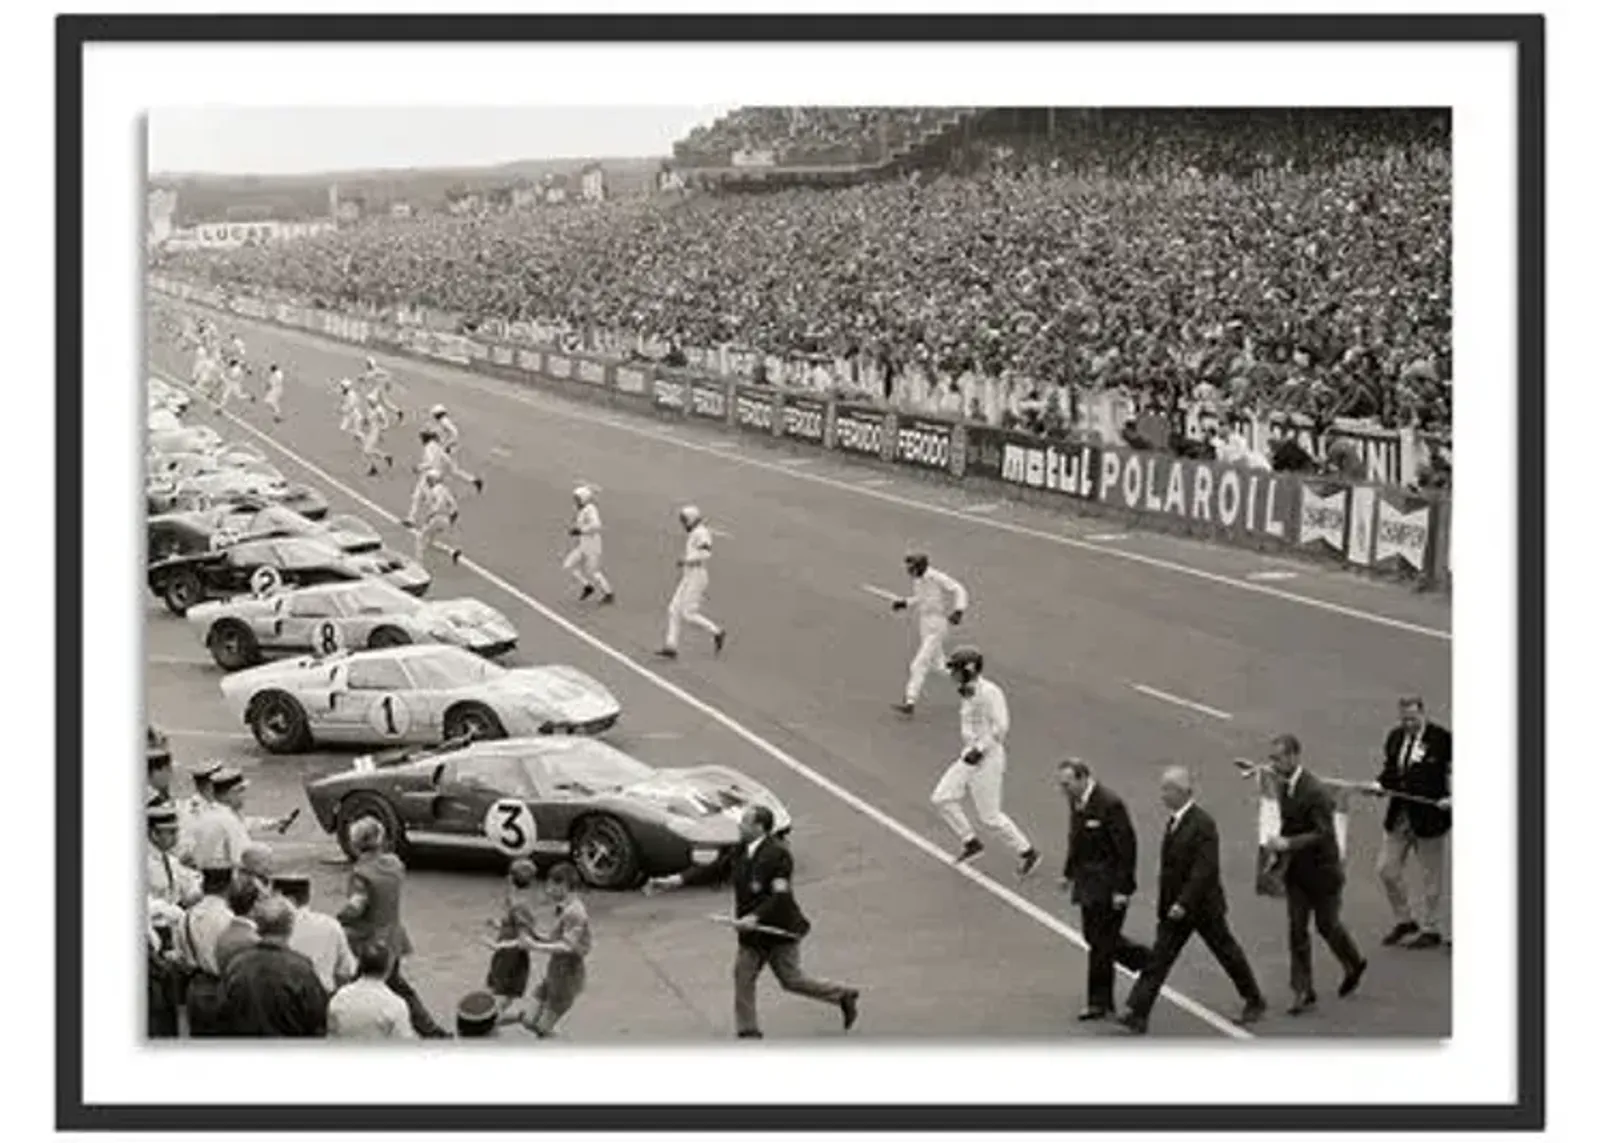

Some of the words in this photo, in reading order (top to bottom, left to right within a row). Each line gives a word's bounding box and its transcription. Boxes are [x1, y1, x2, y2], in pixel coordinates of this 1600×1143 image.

[1101, 451, 1285, 536] POLAROIL
[322, 622, 335, 653] 8
[381, 696, 398, 734] 1
[497, 803, 525, 848] 3
